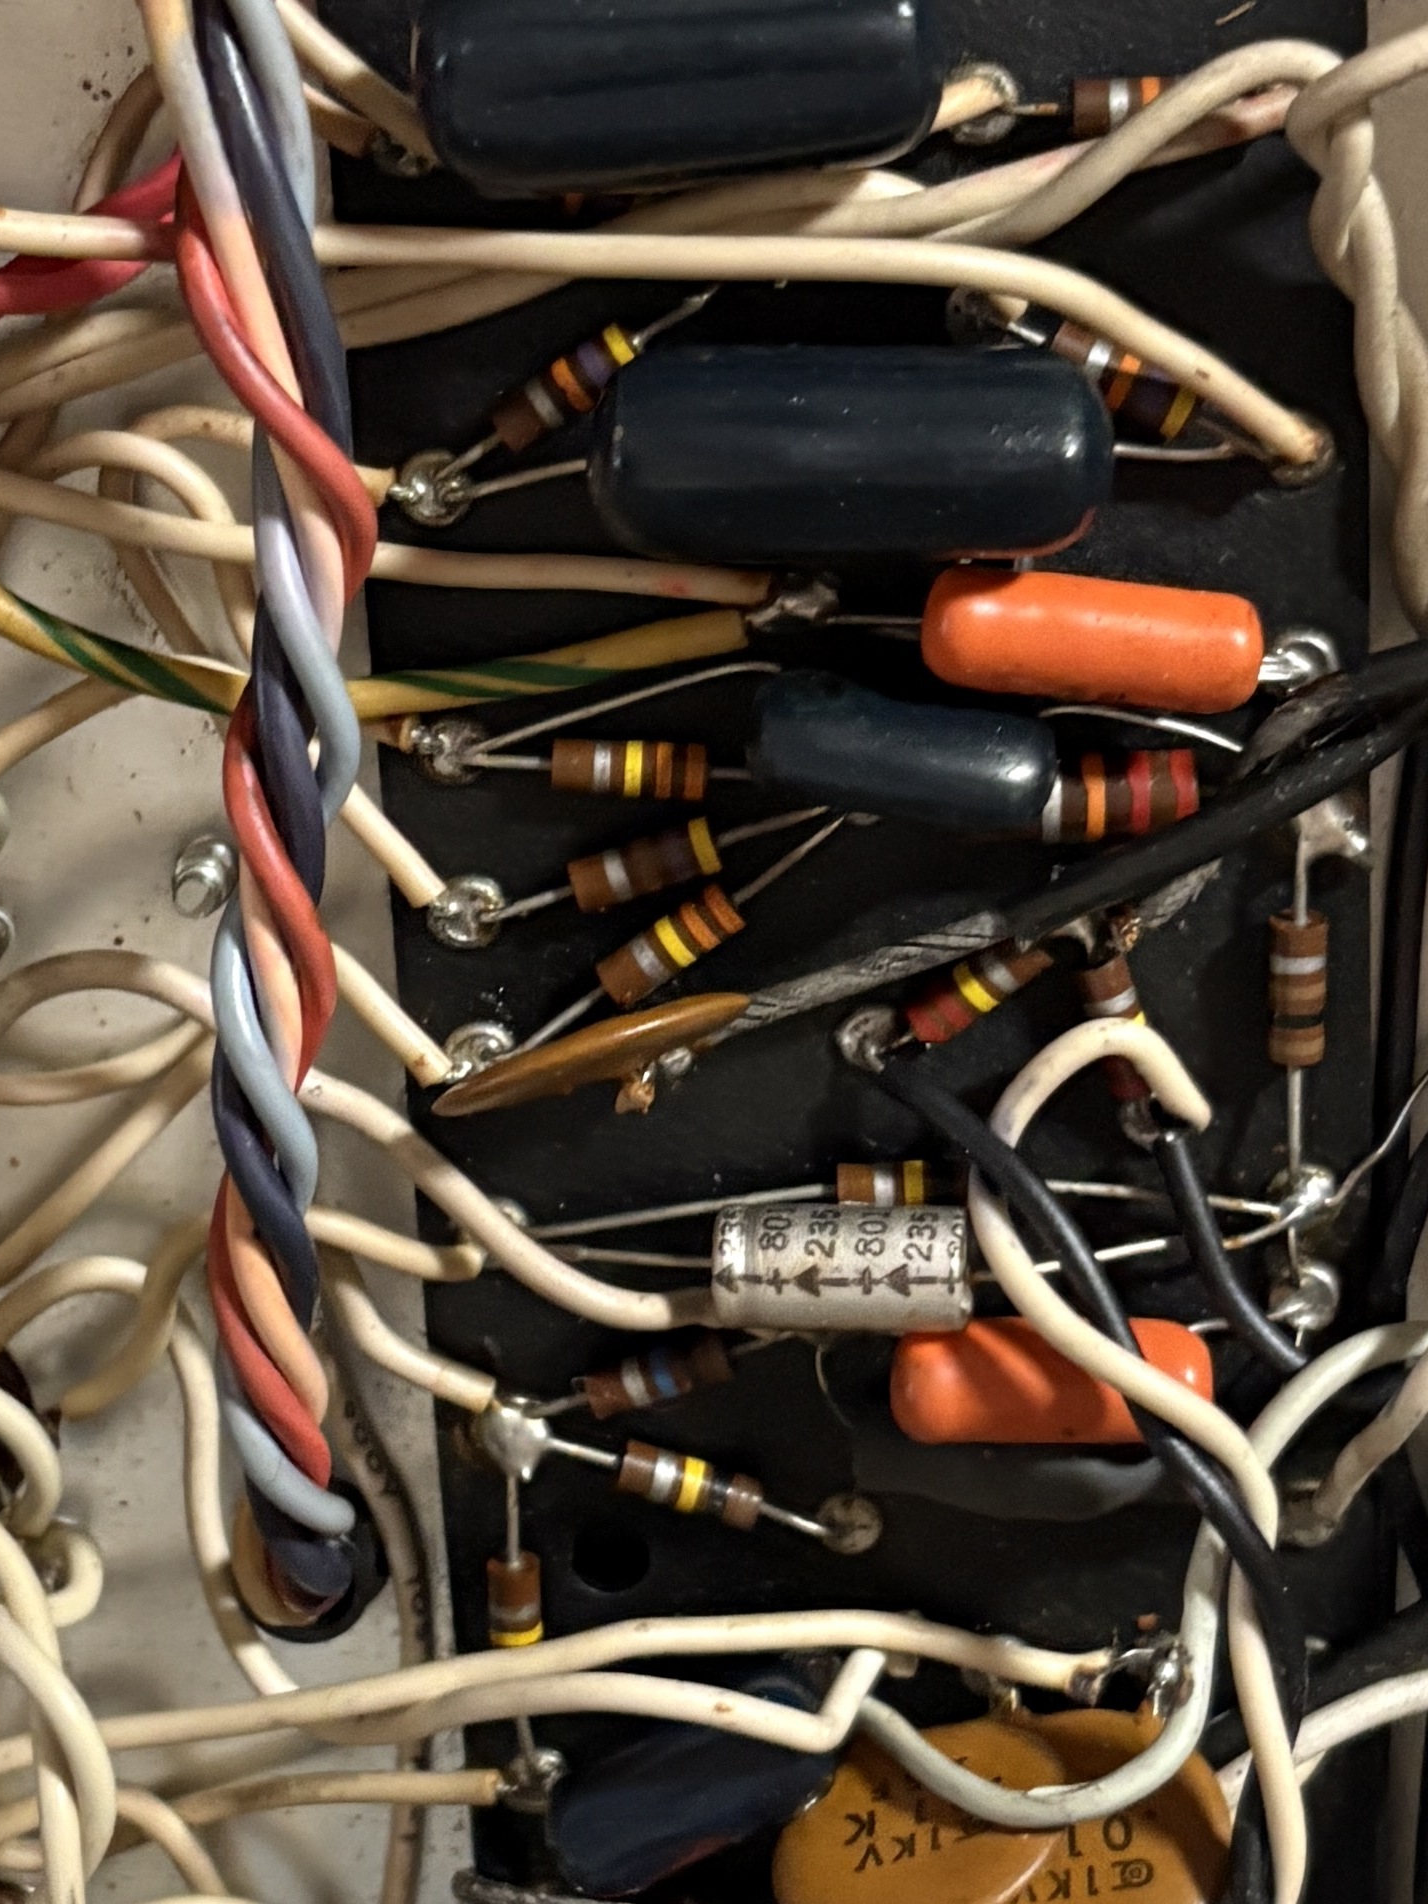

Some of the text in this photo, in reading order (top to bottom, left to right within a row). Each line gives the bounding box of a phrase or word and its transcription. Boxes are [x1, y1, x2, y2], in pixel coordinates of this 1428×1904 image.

[802, 1209, 843, 1259] 235
[901, 1210, 941, 1263] 235
[853, 1826, 942, 1874] 1KV
